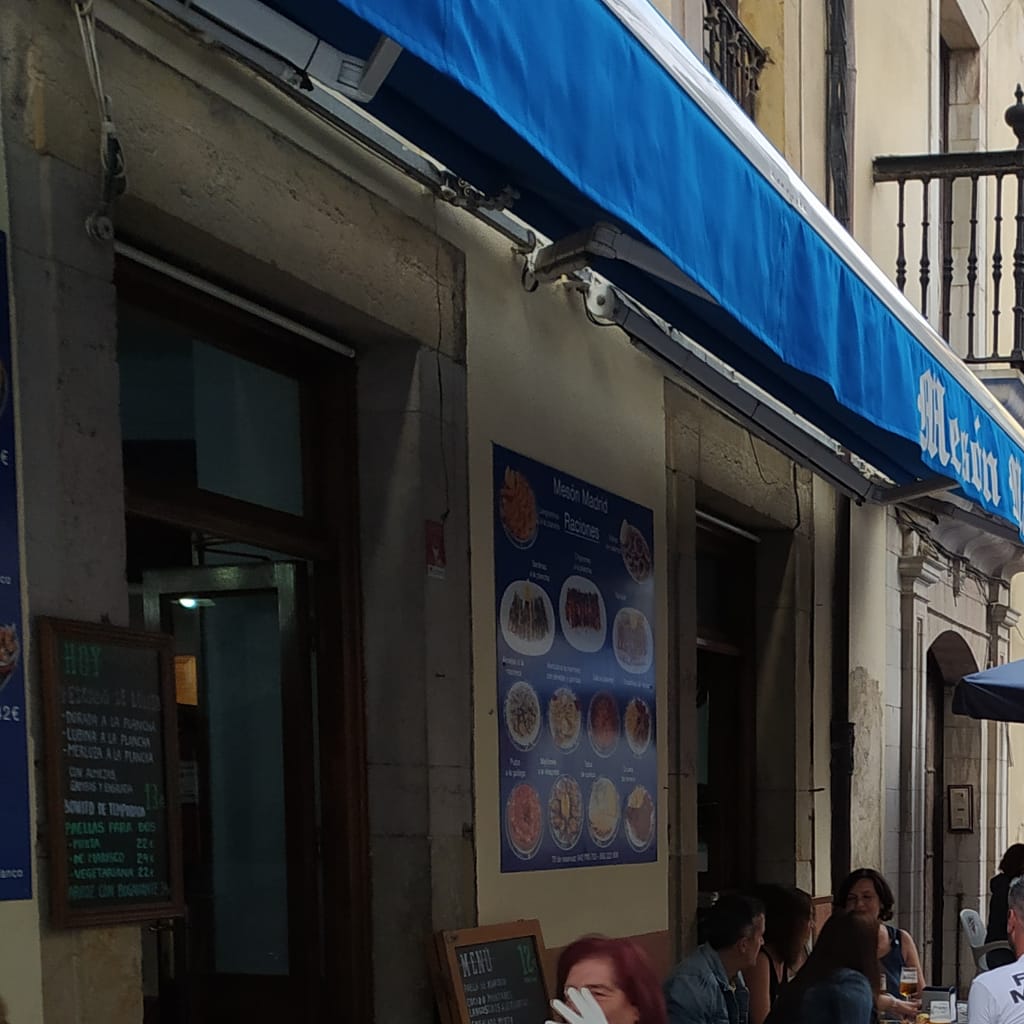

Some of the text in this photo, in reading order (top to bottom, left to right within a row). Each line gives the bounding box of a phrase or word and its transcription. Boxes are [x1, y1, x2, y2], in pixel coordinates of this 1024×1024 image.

[552, 475, 609, 515] Mesón Madrid
[563, 510, 601, 541] Raciones
[0, 704, 20, 722] 2€
[108, 821, 132, 834] PARA
[136, 821, 158, 833] DOS
